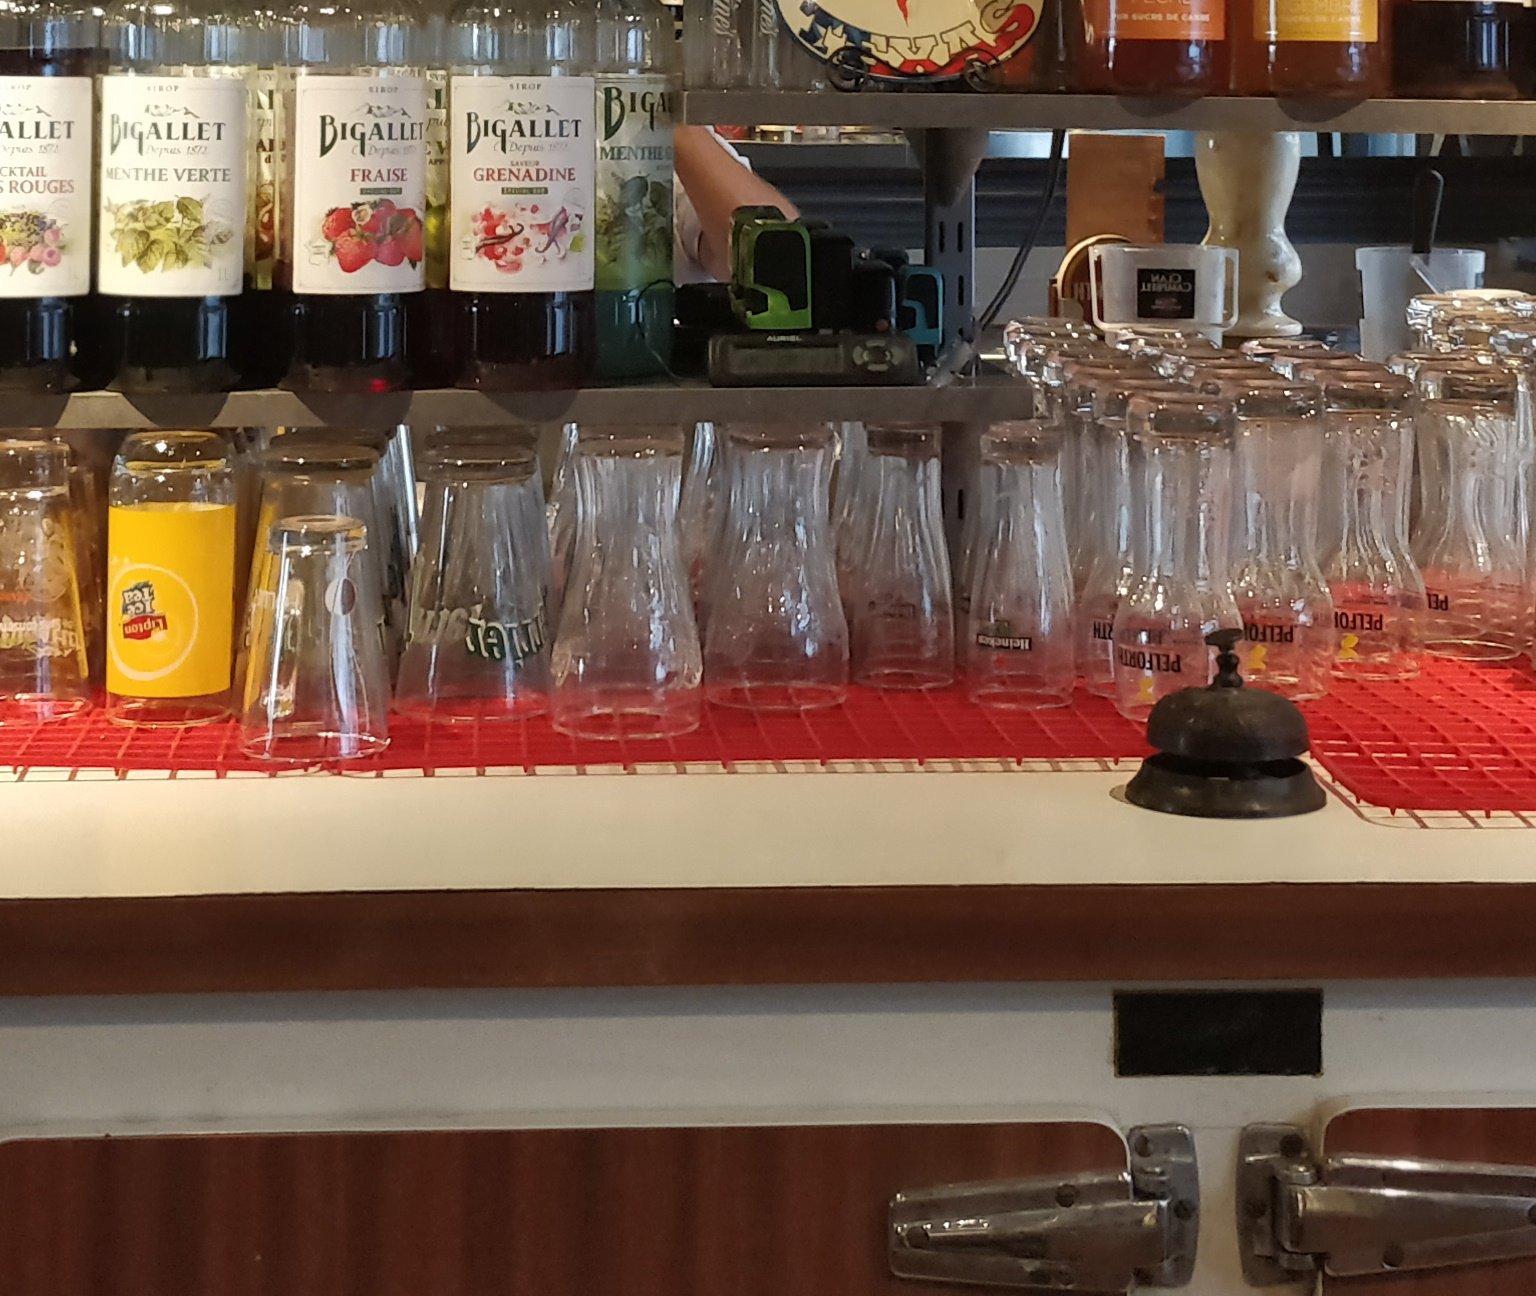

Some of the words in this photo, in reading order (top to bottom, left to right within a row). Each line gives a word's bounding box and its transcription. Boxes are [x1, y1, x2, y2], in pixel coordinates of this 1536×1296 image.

[509, 83, 542, 91] SIROP
[110, 113, 227, 157] BIGALLET
[466, 111, 582, 155] BIGALLET
[105, 167, 169, 183] MENTHE
[173, 167, 232, 183] VERTE
[350, 167, 409, 183] FRAISE
[473, 167, 576, 182] GRENADINE
[8, 179, 75, 194] ROUGES
[124, 615, 167, 636] Lipton
